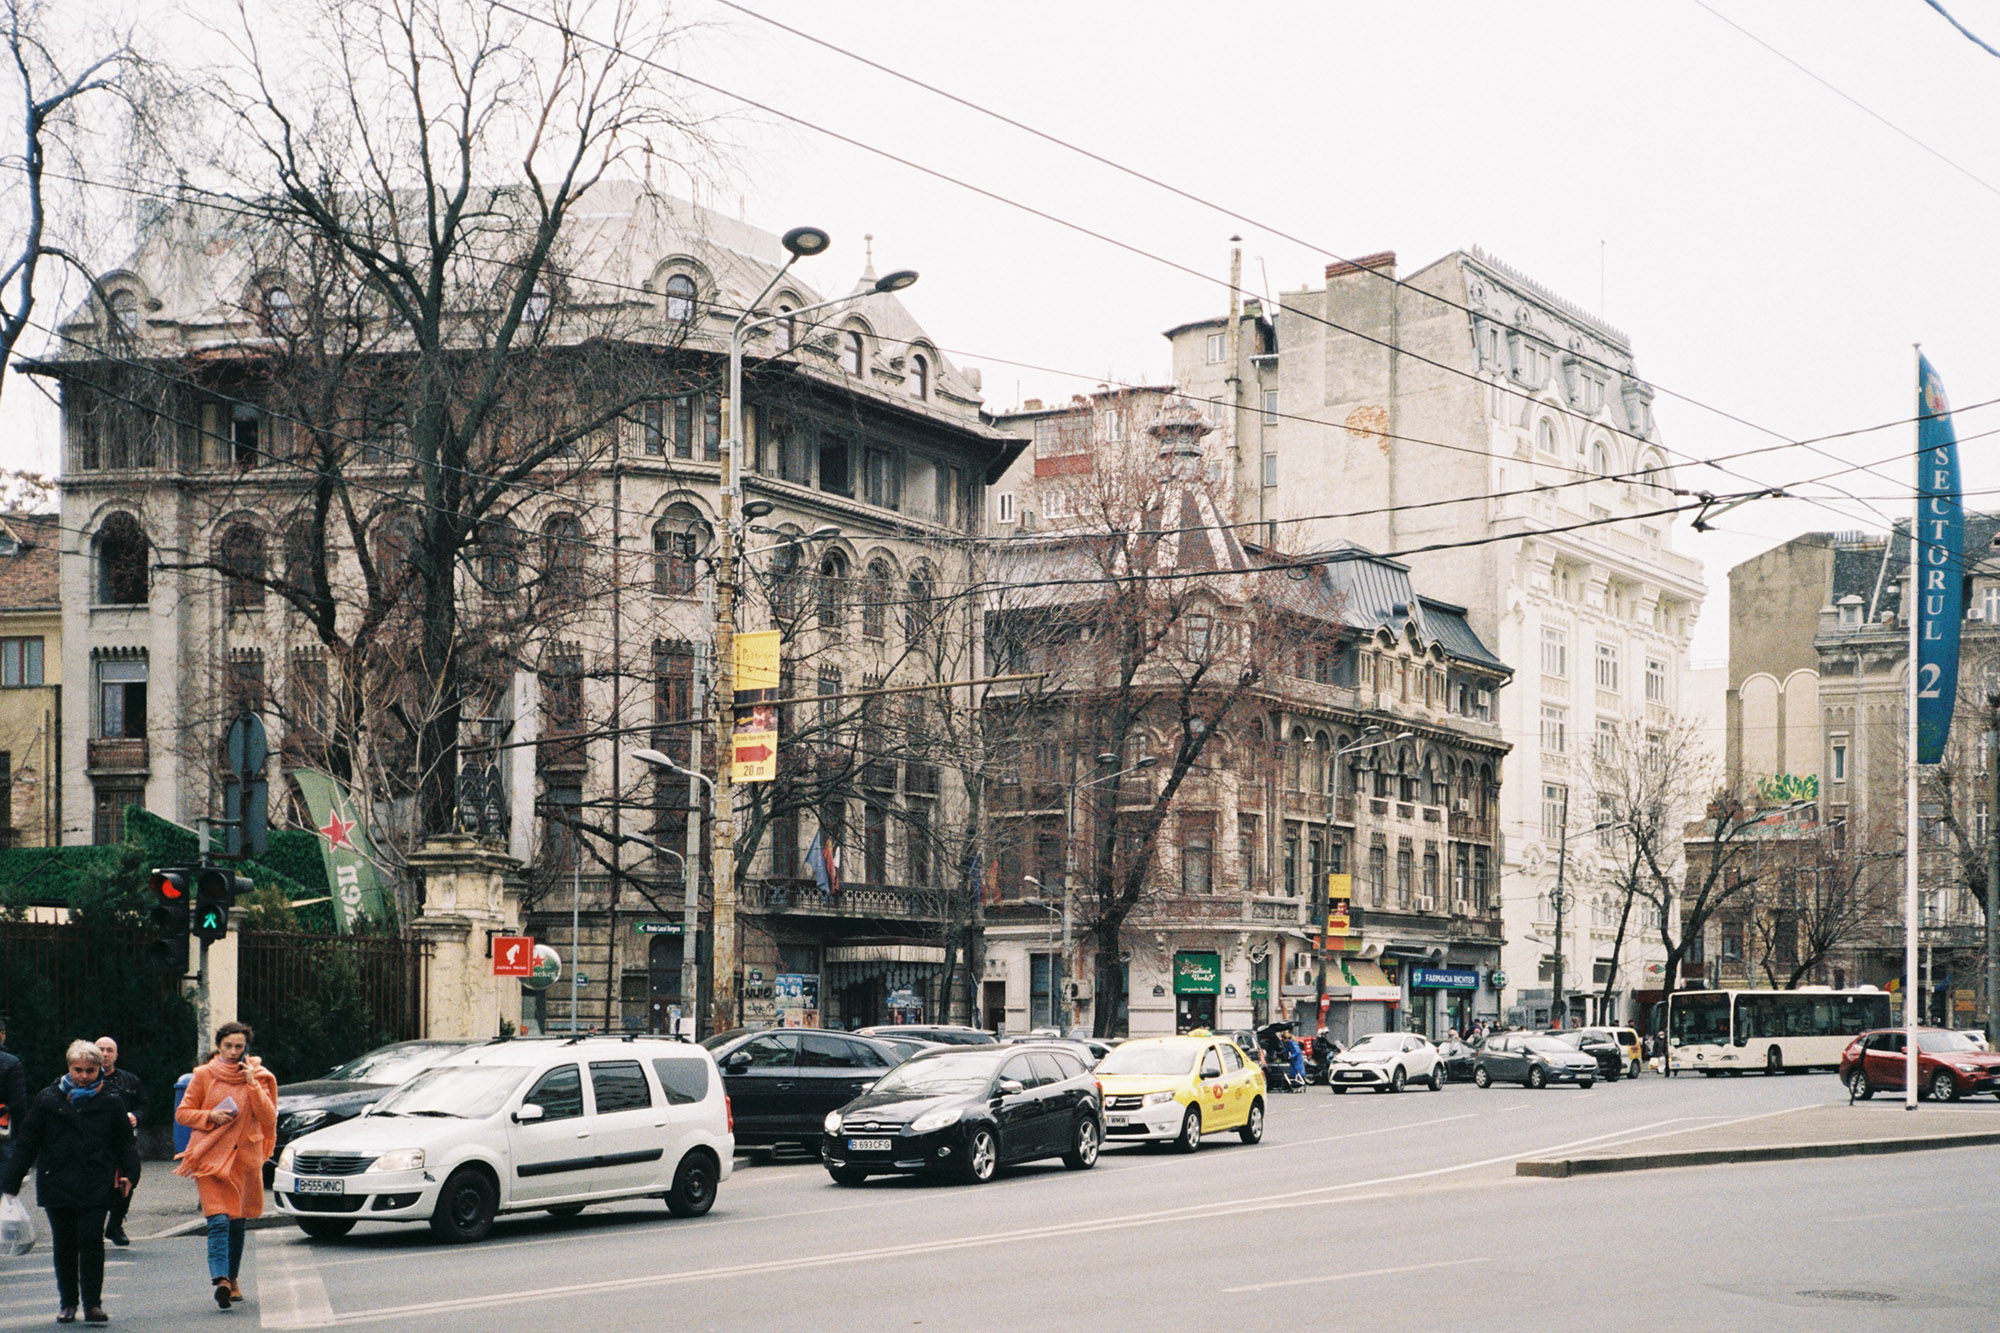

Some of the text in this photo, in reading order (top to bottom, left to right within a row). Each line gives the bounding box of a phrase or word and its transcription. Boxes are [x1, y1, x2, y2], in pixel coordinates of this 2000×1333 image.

[1924, 446, 1951, 641] SECTORUL
[1918, 662, 1942, 699] 2
[743, 764, 764, 776] 20 m
[831, 945, 893, 961] HOTEL BANAT
[905, 946, 929, 961] HOTEL
[1425, 974, 1476, 984] FARMACIA RICHTER
